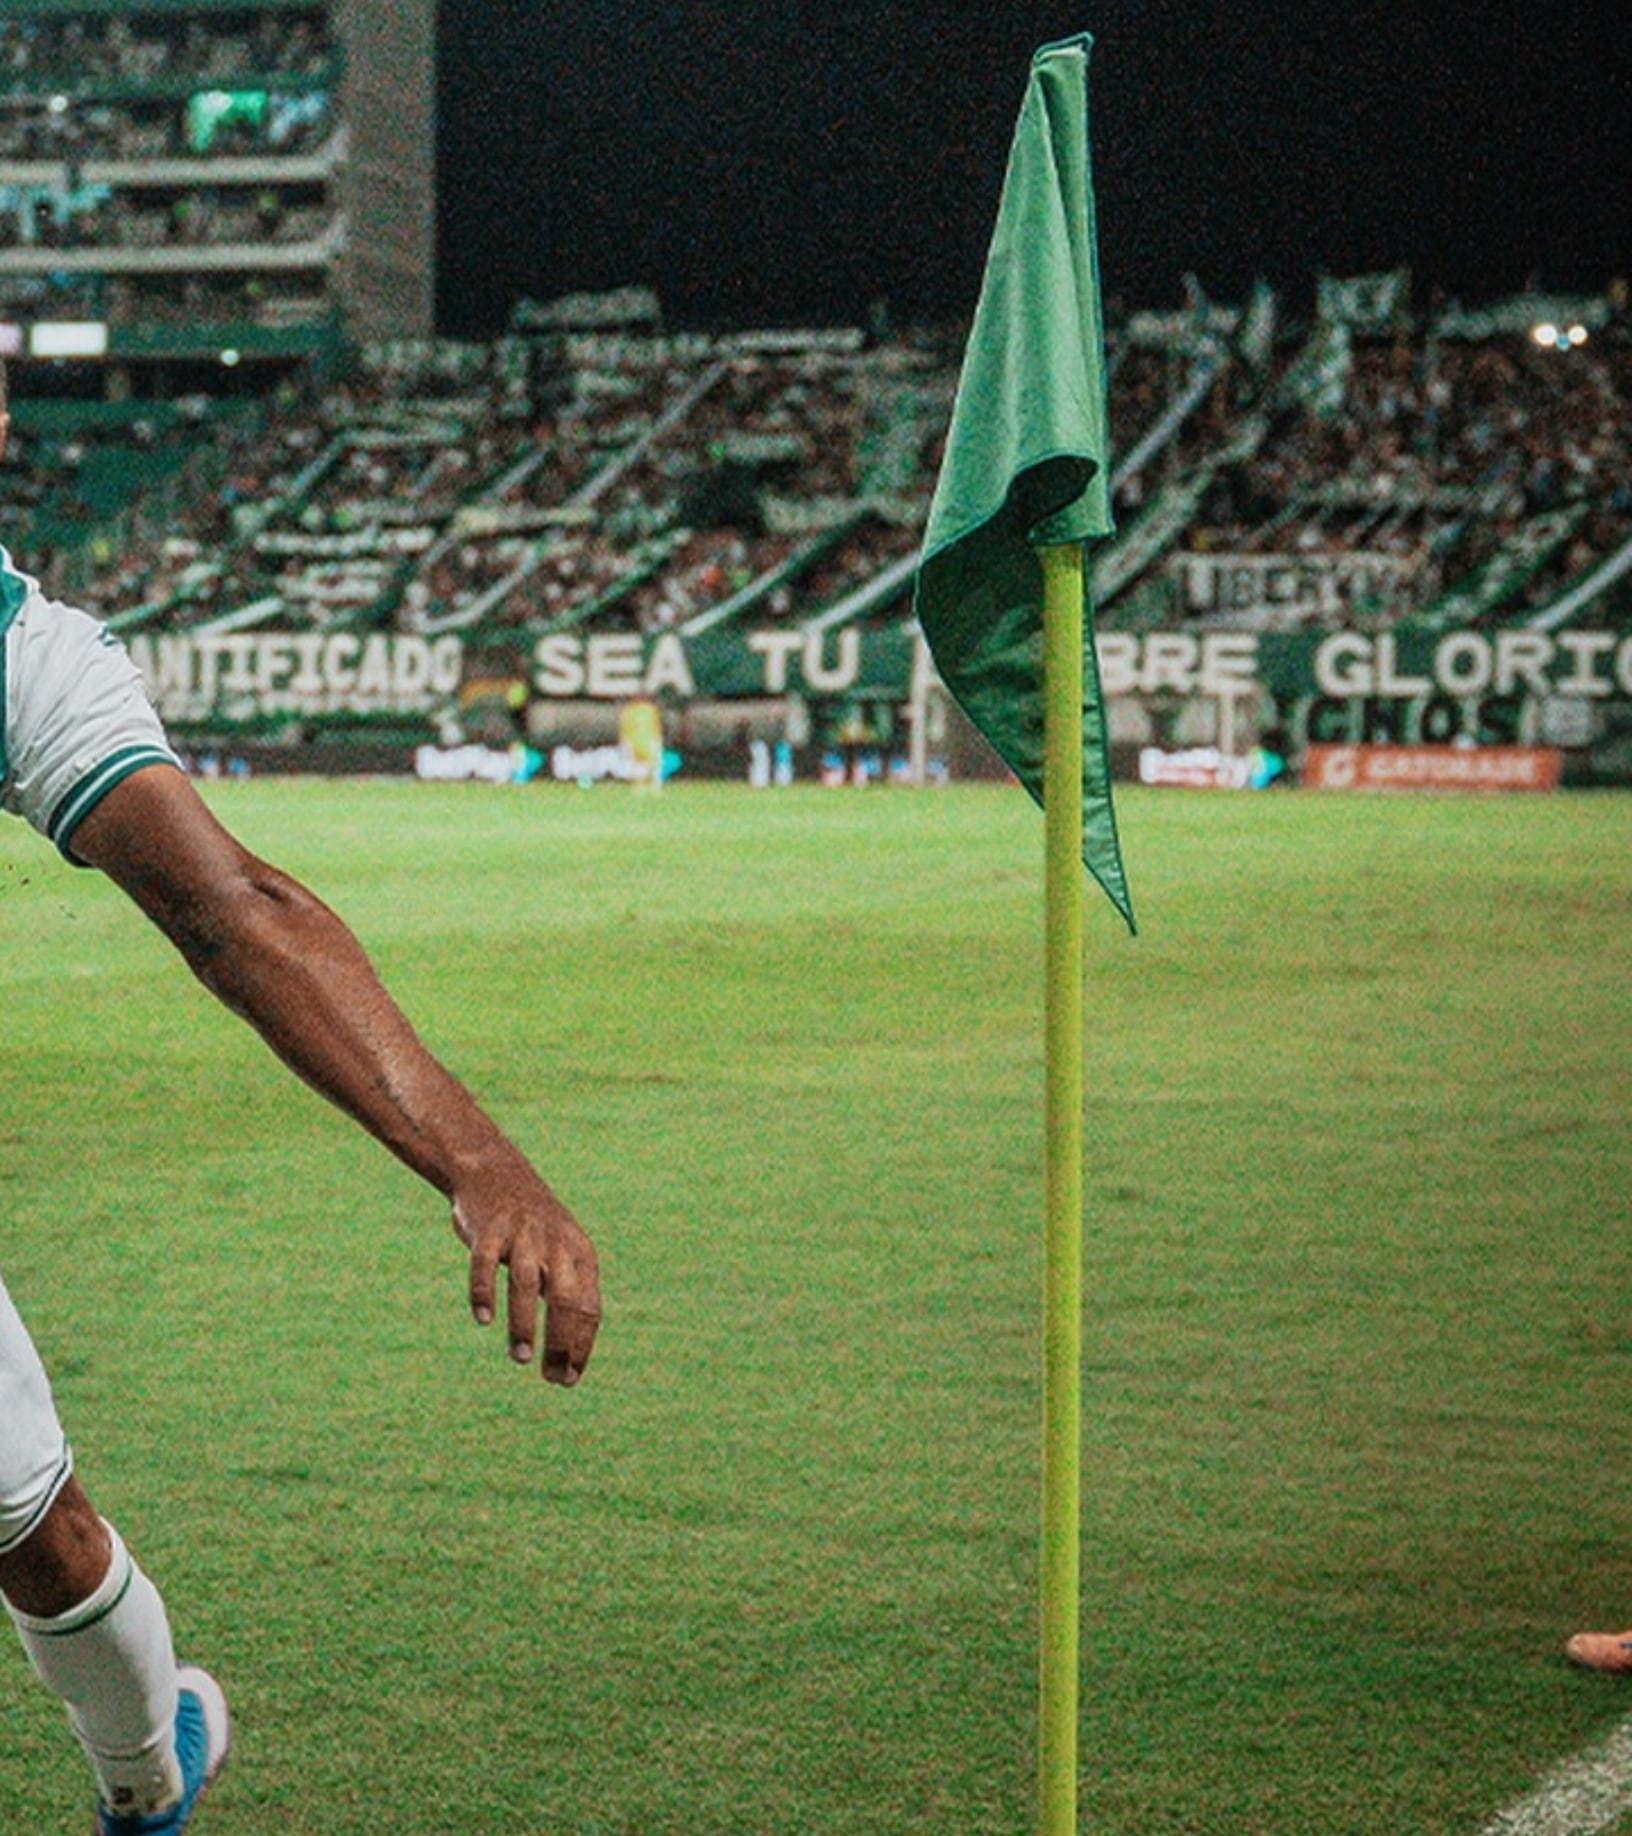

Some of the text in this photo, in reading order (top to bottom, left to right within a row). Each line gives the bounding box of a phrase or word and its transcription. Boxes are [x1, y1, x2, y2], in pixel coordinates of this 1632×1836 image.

[126, 630, 464, 702] ANTIFICADO
[534, 632, 696, 696] SEA
[748, 629, 861, 694] TU
